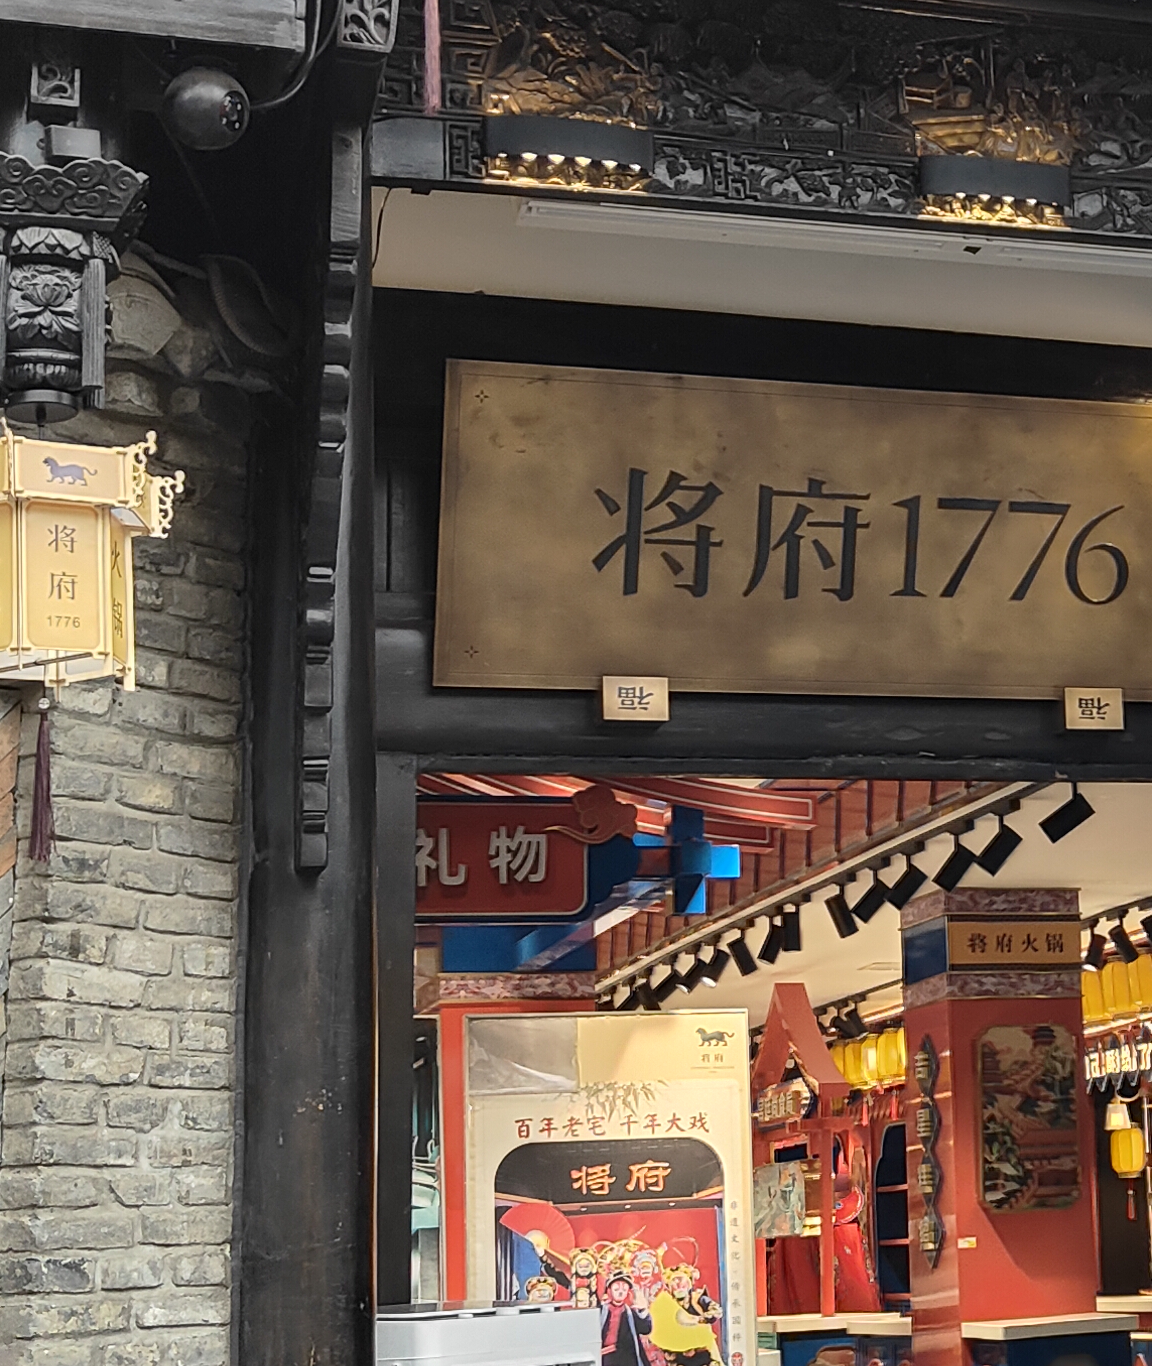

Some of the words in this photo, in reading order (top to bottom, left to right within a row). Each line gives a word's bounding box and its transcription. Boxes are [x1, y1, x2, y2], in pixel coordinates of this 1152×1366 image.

[592, 466, 1130, 606] 将府1776
[47, 524, 78, 601] 将府
[46, 615, 81, 629] 1776
[415, 825, 548, 888] 礼物
[966, 931, 1065, 955] 将府火锅
[514, 1115, 606, 1139] 百年老宅
[619, 1111, 711, 1135] 千年大戏
[570, 1159, 672, 1196] 将府
